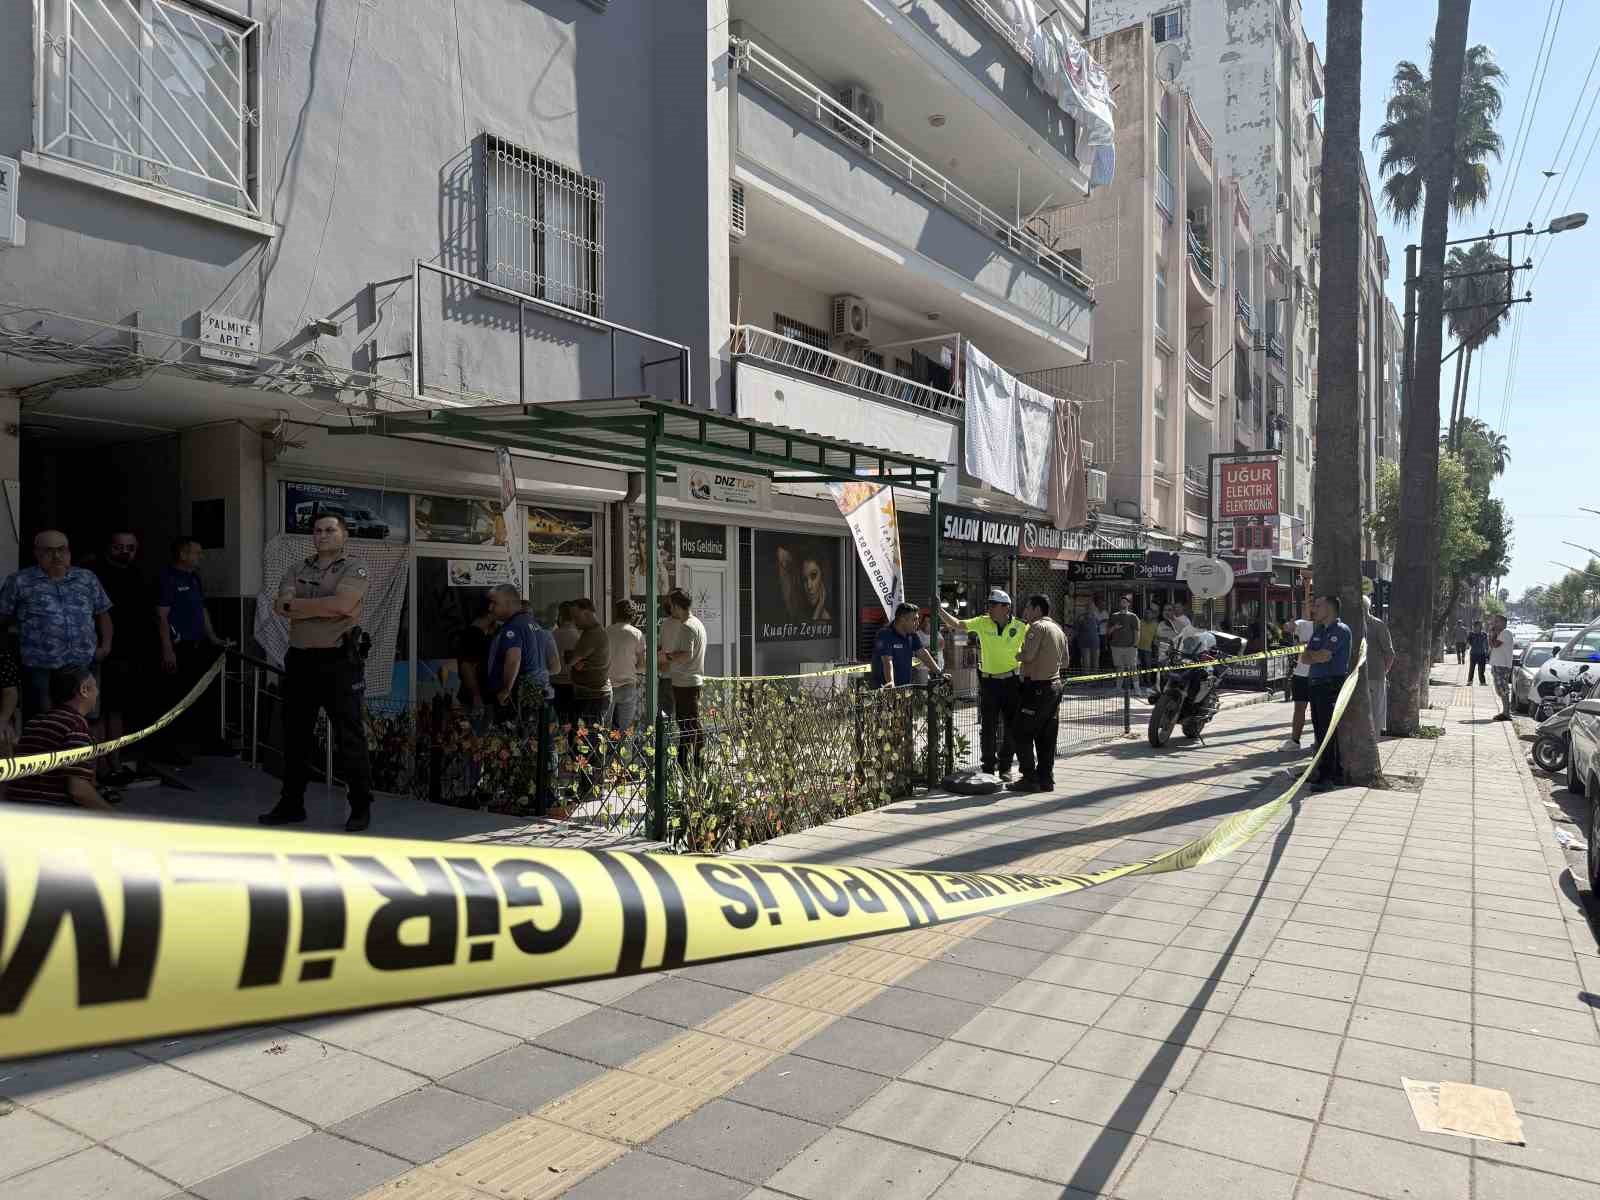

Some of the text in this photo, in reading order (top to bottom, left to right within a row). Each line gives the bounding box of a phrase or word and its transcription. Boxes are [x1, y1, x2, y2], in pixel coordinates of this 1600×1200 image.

[1227, 467, 1271, 483] UĞUR
[944, 515, 1020, 547] SALON VOLKAN
[696, 863, 886, 930] POLİS
